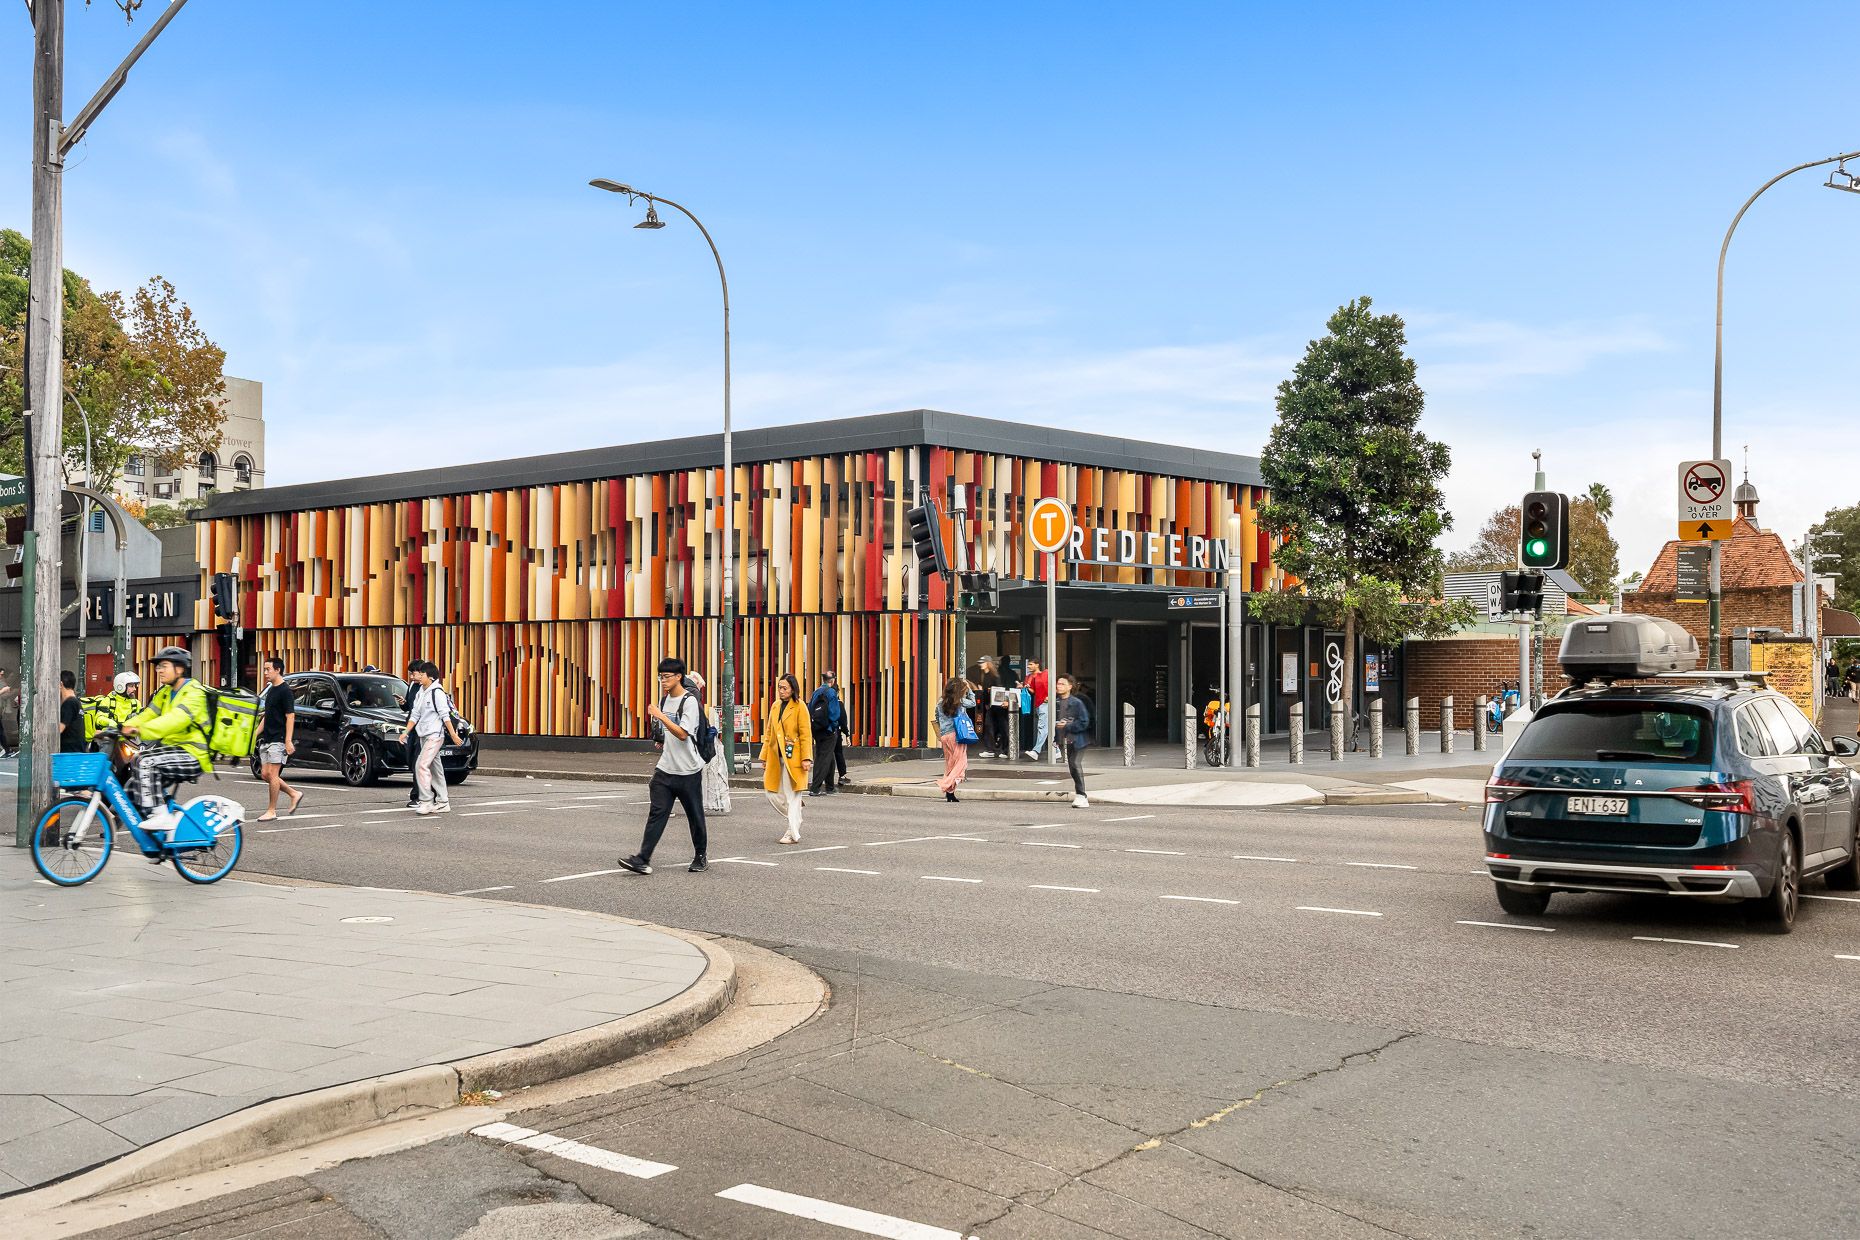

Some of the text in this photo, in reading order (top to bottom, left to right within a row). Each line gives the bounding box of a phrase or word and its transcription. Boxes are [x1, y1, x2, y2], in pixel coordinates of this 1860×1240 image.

[1701, 504, 1722, 512] AND
[1040, 512, 1057, 542] T
[1069, 525, 1230, 570] REDFERN
